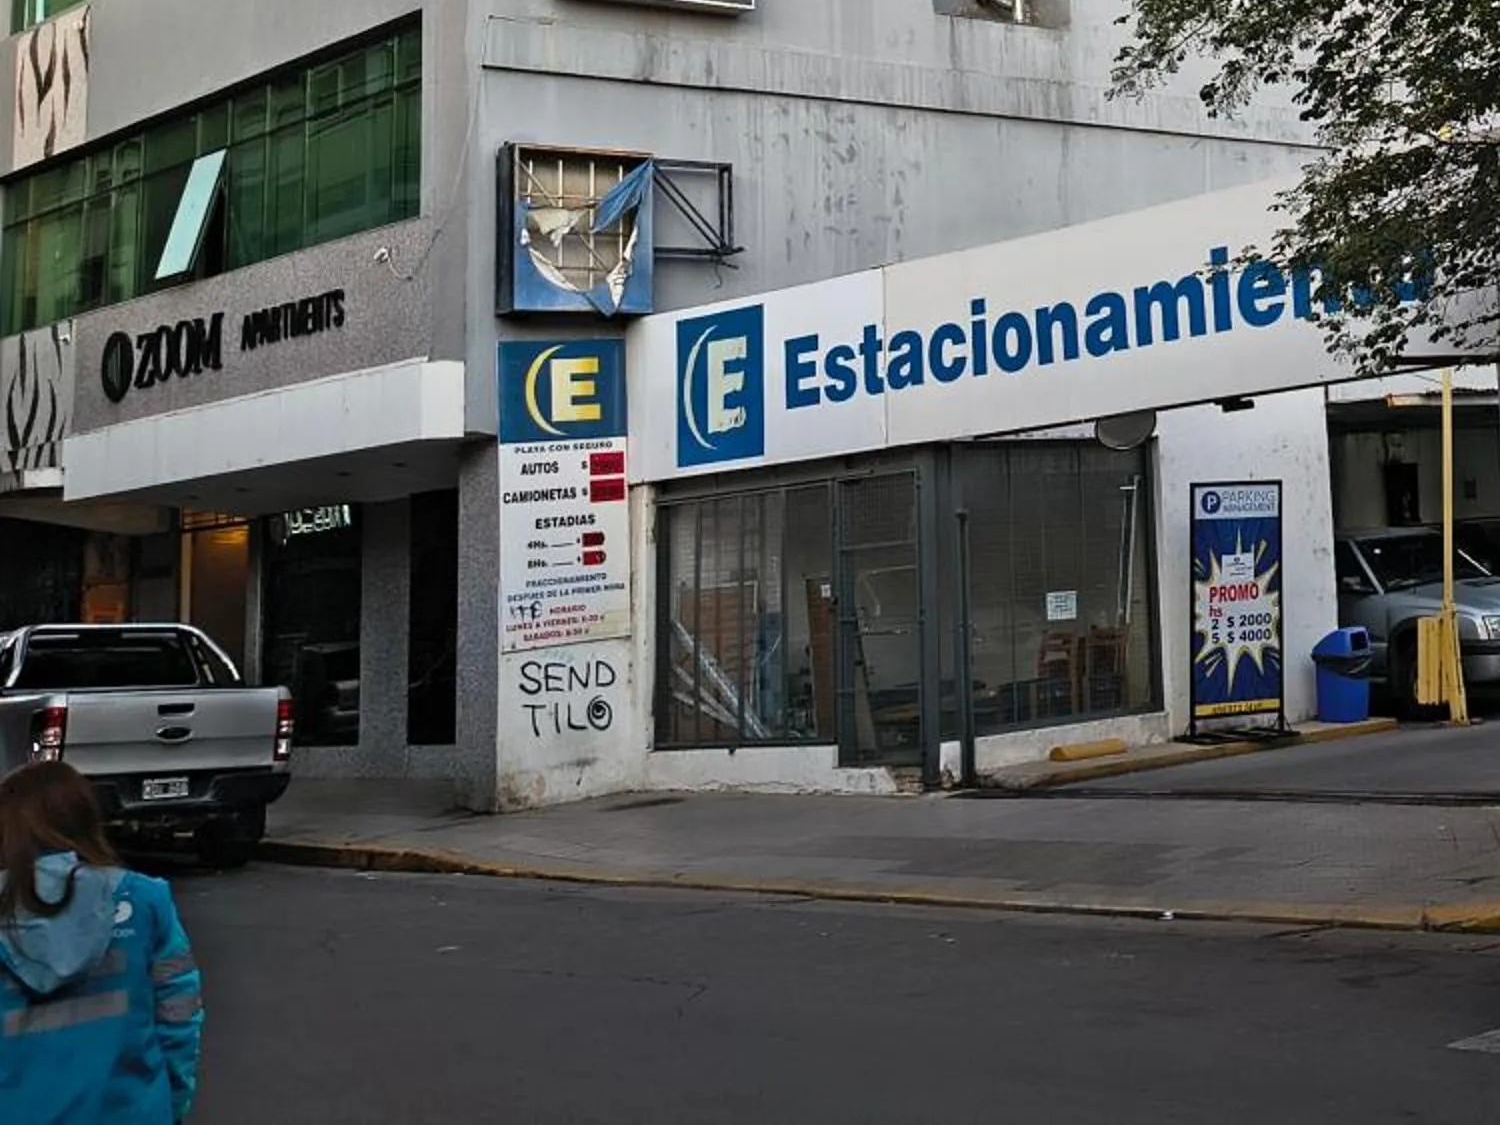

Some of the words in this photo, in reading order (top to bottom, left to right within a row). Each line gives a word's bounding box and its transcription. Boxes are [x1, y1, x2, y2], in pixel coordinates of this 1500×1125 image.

[784, 241, 1436, 410] Estacionamien
[133, 312, 225, 389] ZOOM
[240, 289, 346, 352] APARTMENTS
[520, 460, 559, 476] AUTOS
[503, 486, 577, 504] CAMIONETAS
[1221, 490, 1275, 502] PARKING
[535, 514, 597, 530] ESTADIAS
[1209, 583, 1260, 604] PROMO
[1208, 604, 1223, 619] hs
[1211, 618, 1220, 631] 2
[1239, 612, 1273, 628] 2000
[1239, 628, 1273, 644] 4000
[518, 660, 616, 696] SEND
